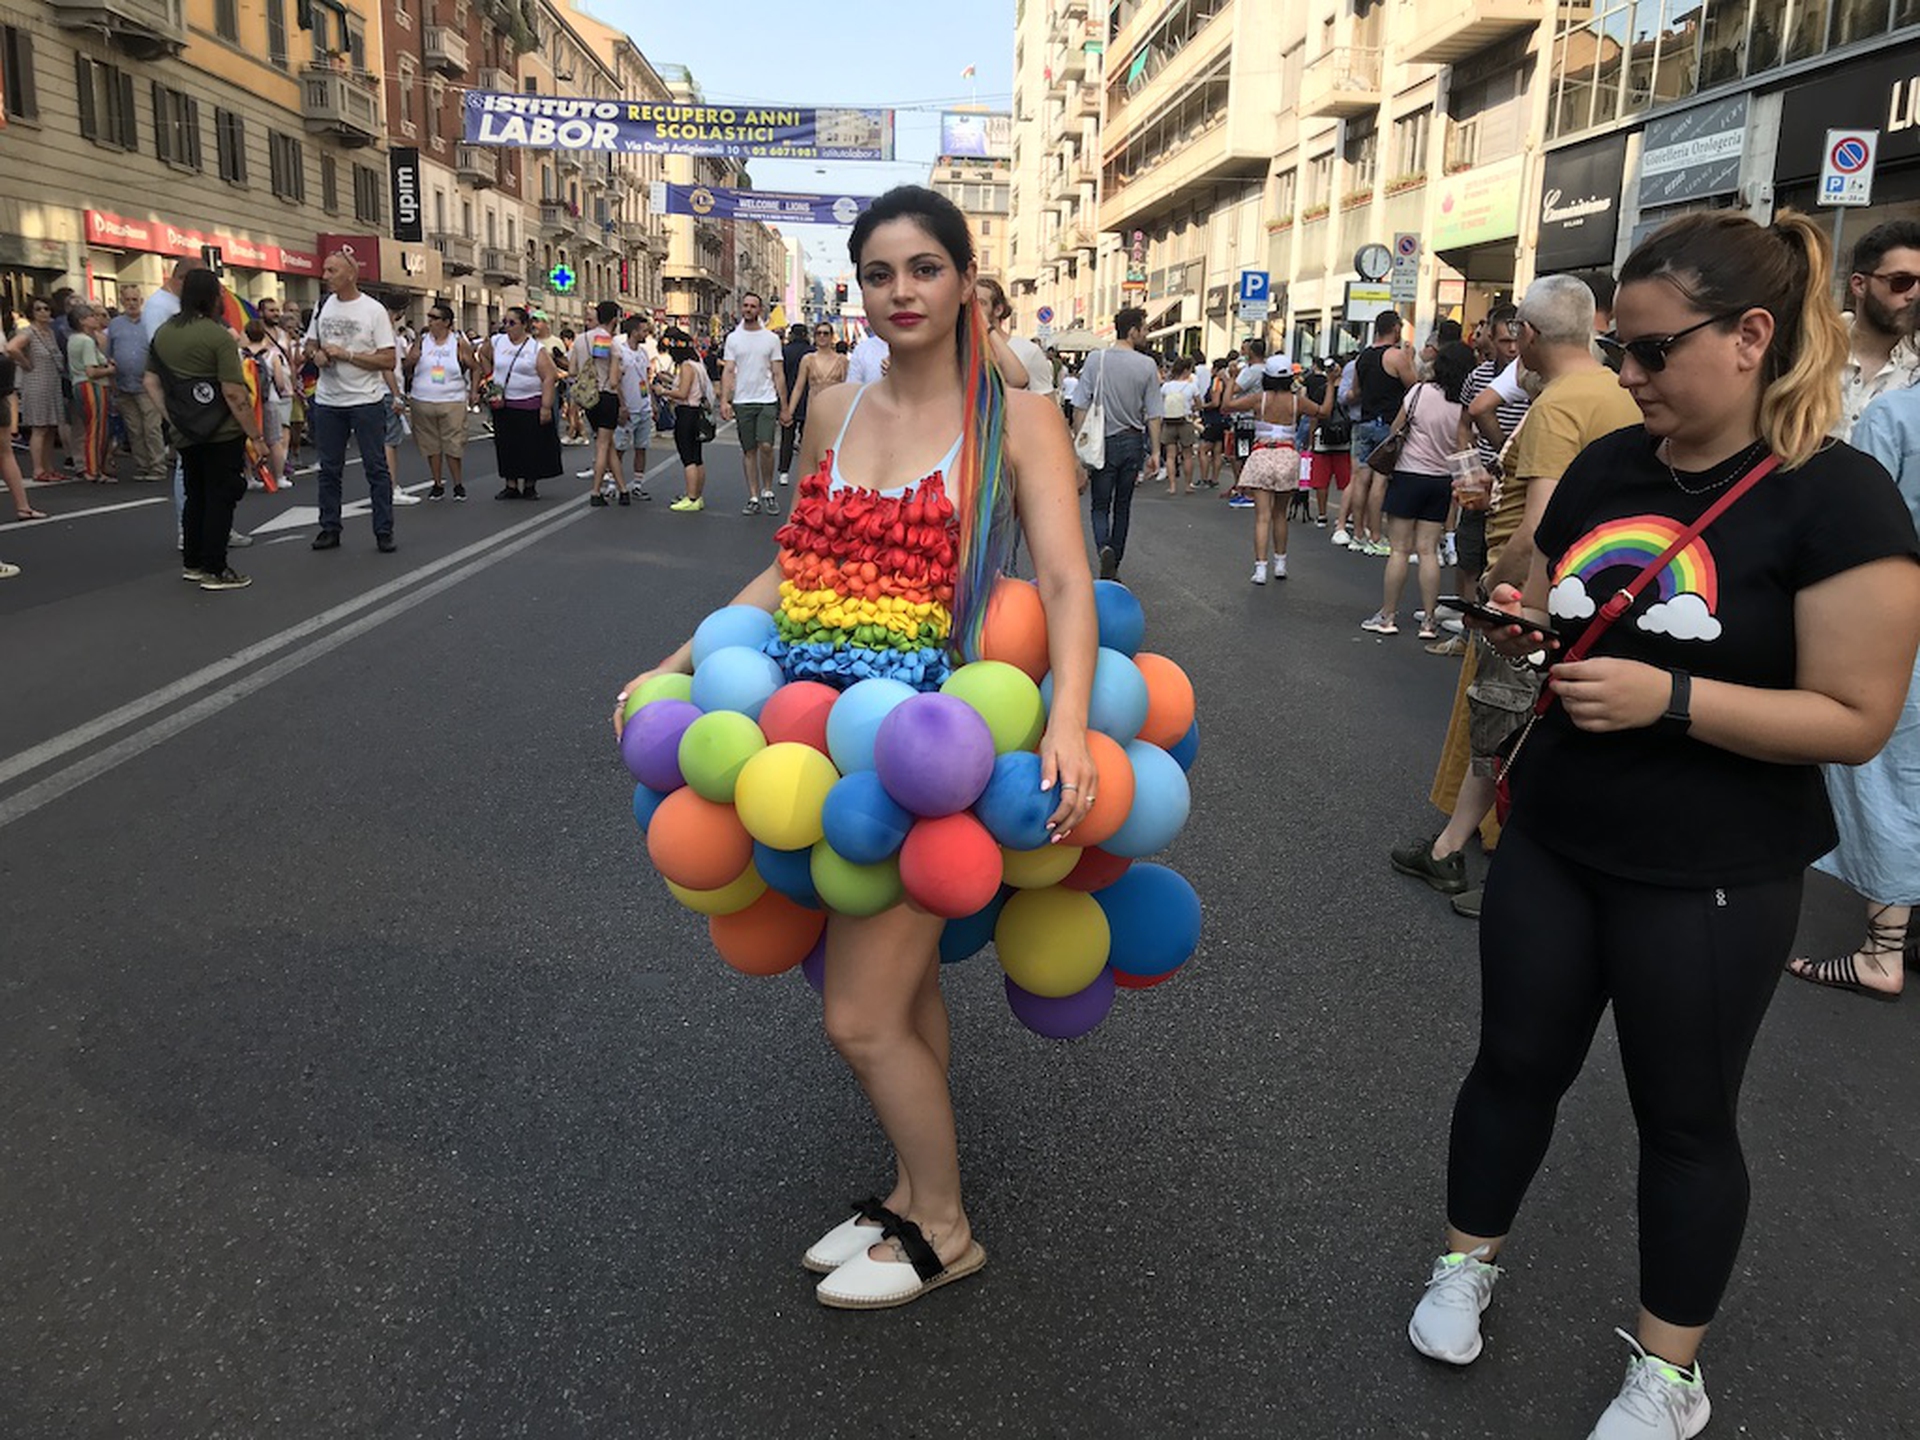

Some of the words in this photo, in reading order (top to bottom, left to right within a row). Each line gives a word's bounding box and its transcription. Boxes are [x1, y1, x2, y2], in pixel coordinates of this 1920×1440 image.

[483, 95, 619, 120] ISTITUTO
[627, 105, 736, 125] RECUPERO
[745, 110, 800, 127] ANNI
[478, 113, 619, 150] LABOR
[655, 123, 774, 142] SCOLASTICI
[624, 141, 642, 151] Via
[727, 145, 740, 155] 10
[751, 146, 767, 156] 02
[398, 166, 419, 224] upim
[739, 198, 780, 211] WELCOME
[785, 201, 811, 212] LIONS
[1245, 273, 1265, 298] P
